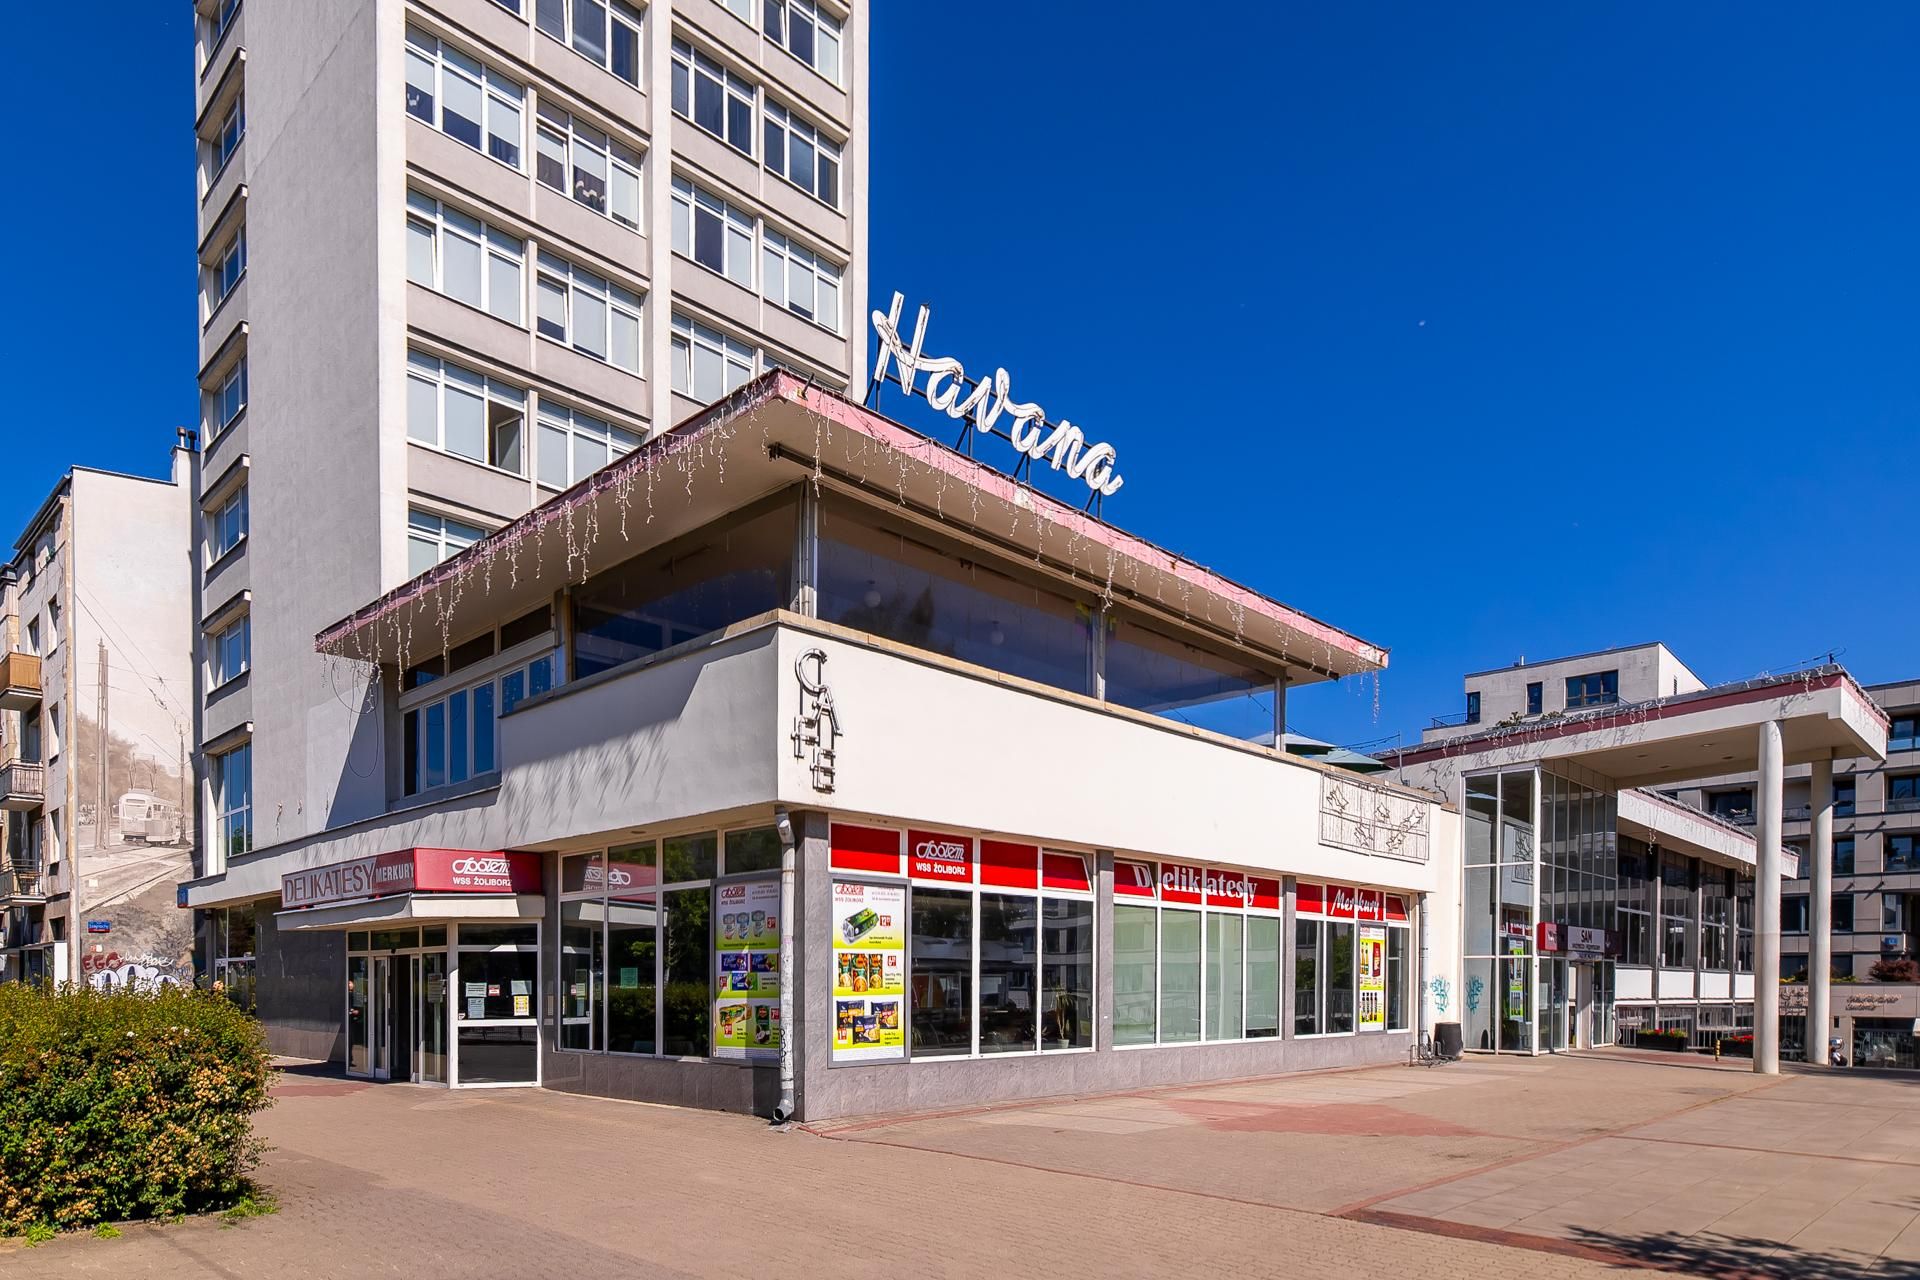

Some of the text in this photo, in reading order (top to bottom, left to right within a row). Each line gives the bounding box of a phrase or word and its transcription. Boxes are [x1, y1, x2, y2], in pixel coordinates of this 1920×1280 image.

[872, 290, 1125, 496] Havana
[790, 648, 843, 794] CAFE
[284, 862, 414, 903] DELIKATESY MERKURY
[452, 875, 513, 887] WSS ŻOLIBORZ
[916, 861, 966, 876] WSS ŻOLIBORZ
